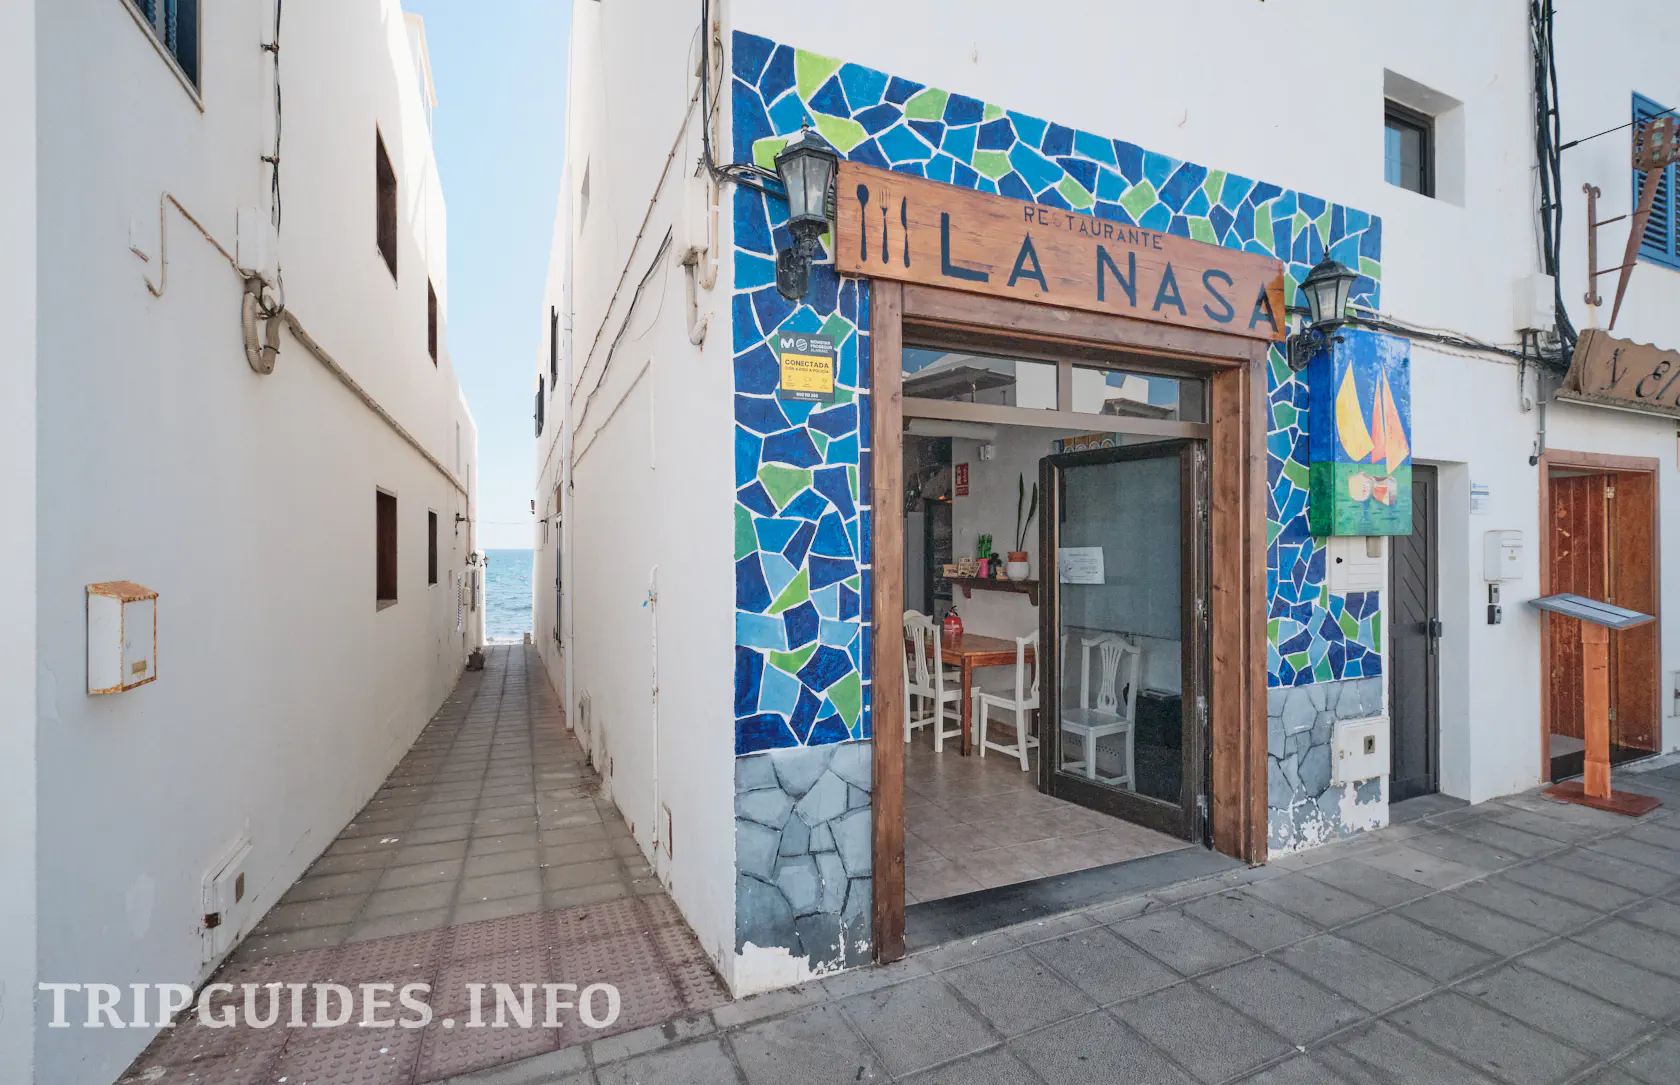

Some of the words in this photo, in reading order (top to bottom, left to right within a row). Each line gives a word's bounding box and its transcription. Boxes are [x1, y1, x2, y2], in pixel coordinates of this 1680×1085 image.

[1023, 205, 1163, 250] RESTAURANTE
[940, 212, 1049, 293] LA
[1096, 245, 1280, 333] NASA
[785, 359, 829, 368] CONECTADA
